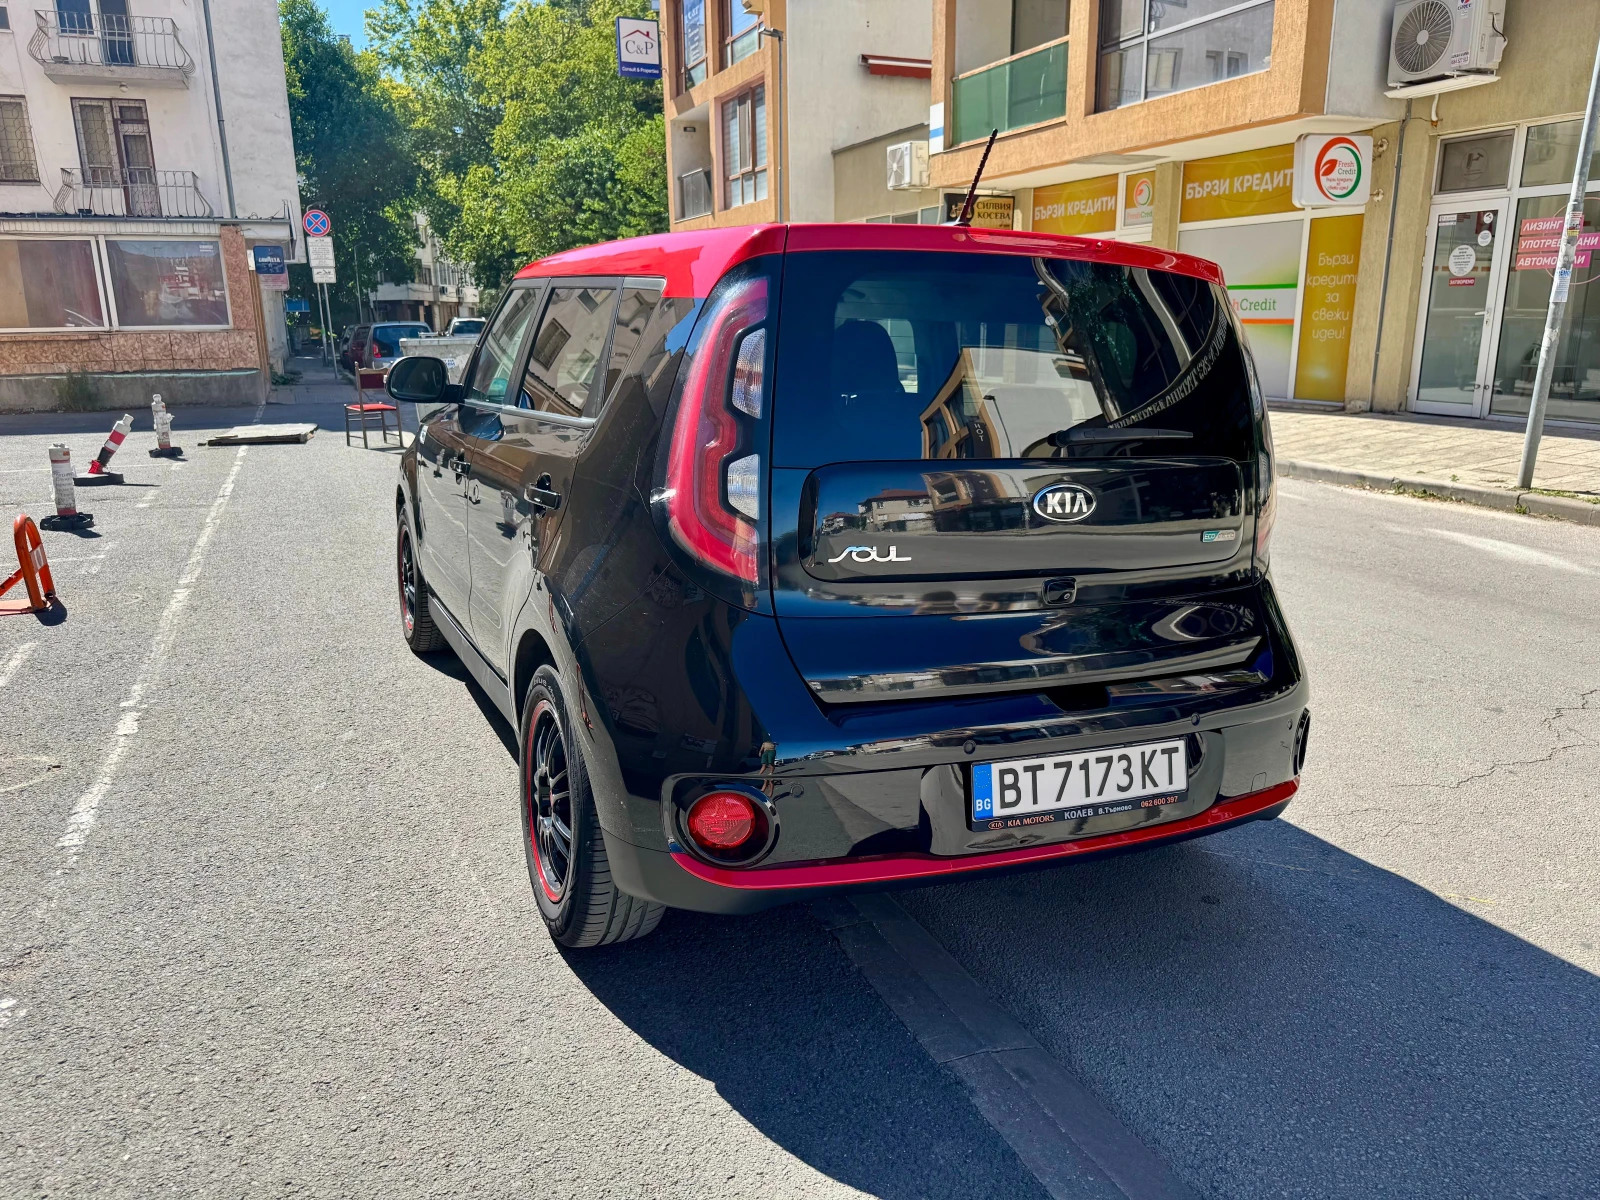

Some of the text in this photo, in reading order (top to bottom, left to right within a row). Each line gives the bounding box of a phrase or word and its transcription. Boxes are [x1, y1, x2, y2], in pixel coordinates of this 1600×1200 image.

[625, 39, 654, 55] C&P
[1338, 160, 1355, 168] Fresh
[1338, 168, 1356, 176] Credit
[1186, 168, 1294, 200] БЪРЗИ КРЕДИТ
[976, 201, 1012, 210] СИЛВИЯ
[1034, 195, 1116, 221] БЪРЗИ КРЕДИТИ
[977, 211, 1011, 220] КОСЕВА
[1126, 210, 1153, 219] FreshCred
[1523, 220, 1563, 231] ЛИЗИНГ
[1521, 236, 1599, 249] УПОТРЕАНИ
[1318, 253, 1354, 268] Бързи
[1325, 292, 1340, 303] за
[1232, 298, 1277, 311] hCredit
[1312, 308, 1350, 321] свежи
[1312, 327, 1346, 341] идеи!
[1046, 492, 1088, 514] KIA
[828, 545, 912, 563] SOUL
[976, 799, 991, 811] BG
[1140, 800, 1153, 808] 062
[1166, 795, 1179, 804] 397
[1022, 814, 1055, 825] MOTORS
[1064, 808, 1094, 820] КОЛЕВ
